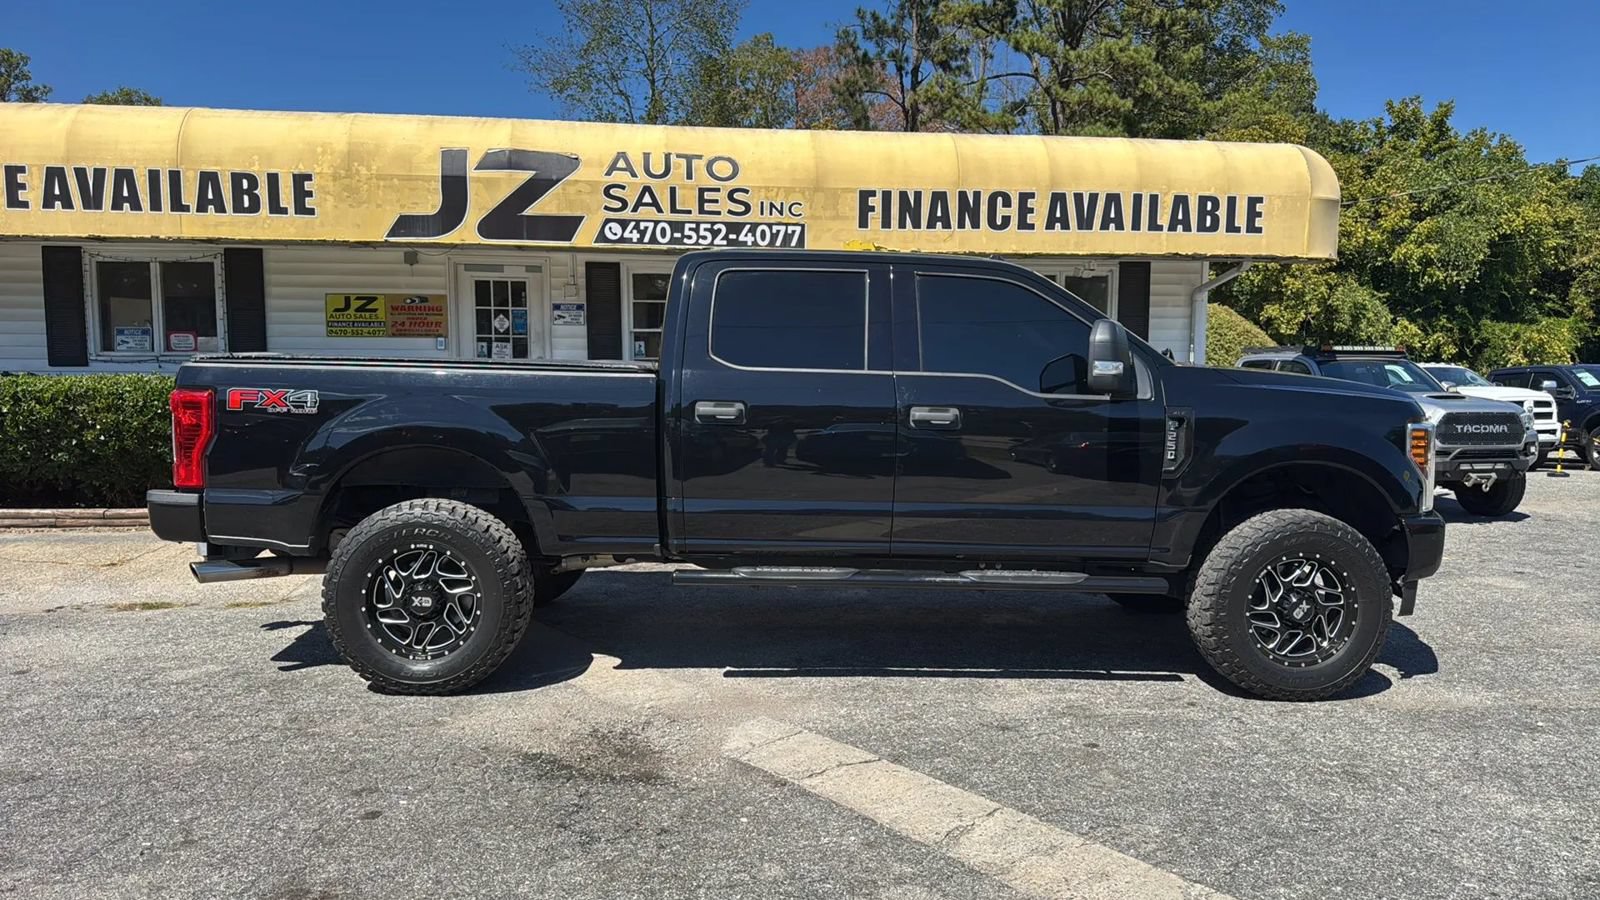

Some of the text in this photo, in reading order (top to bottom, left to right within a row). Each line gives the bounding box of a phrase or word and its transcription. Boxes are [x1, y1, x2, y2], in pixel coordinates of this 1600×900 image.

[603, 151, 740, 182] AUTO
[40, 165, 318, 217] AVAILABLE
[384, 146, 586, 243] JZ
[602, 183, 804, 218] SALES INC
[856, 188, 1266, 235] FINANCE AVAILABLE
[622, 220, 803, 248] 470-552-4077
[332, 295, 379, 313] JZ
[390, 304, 443, 312] WARNING
[226, 387, 320, 411] FX4
[1455, 423, 1509, 435] TACOMA
